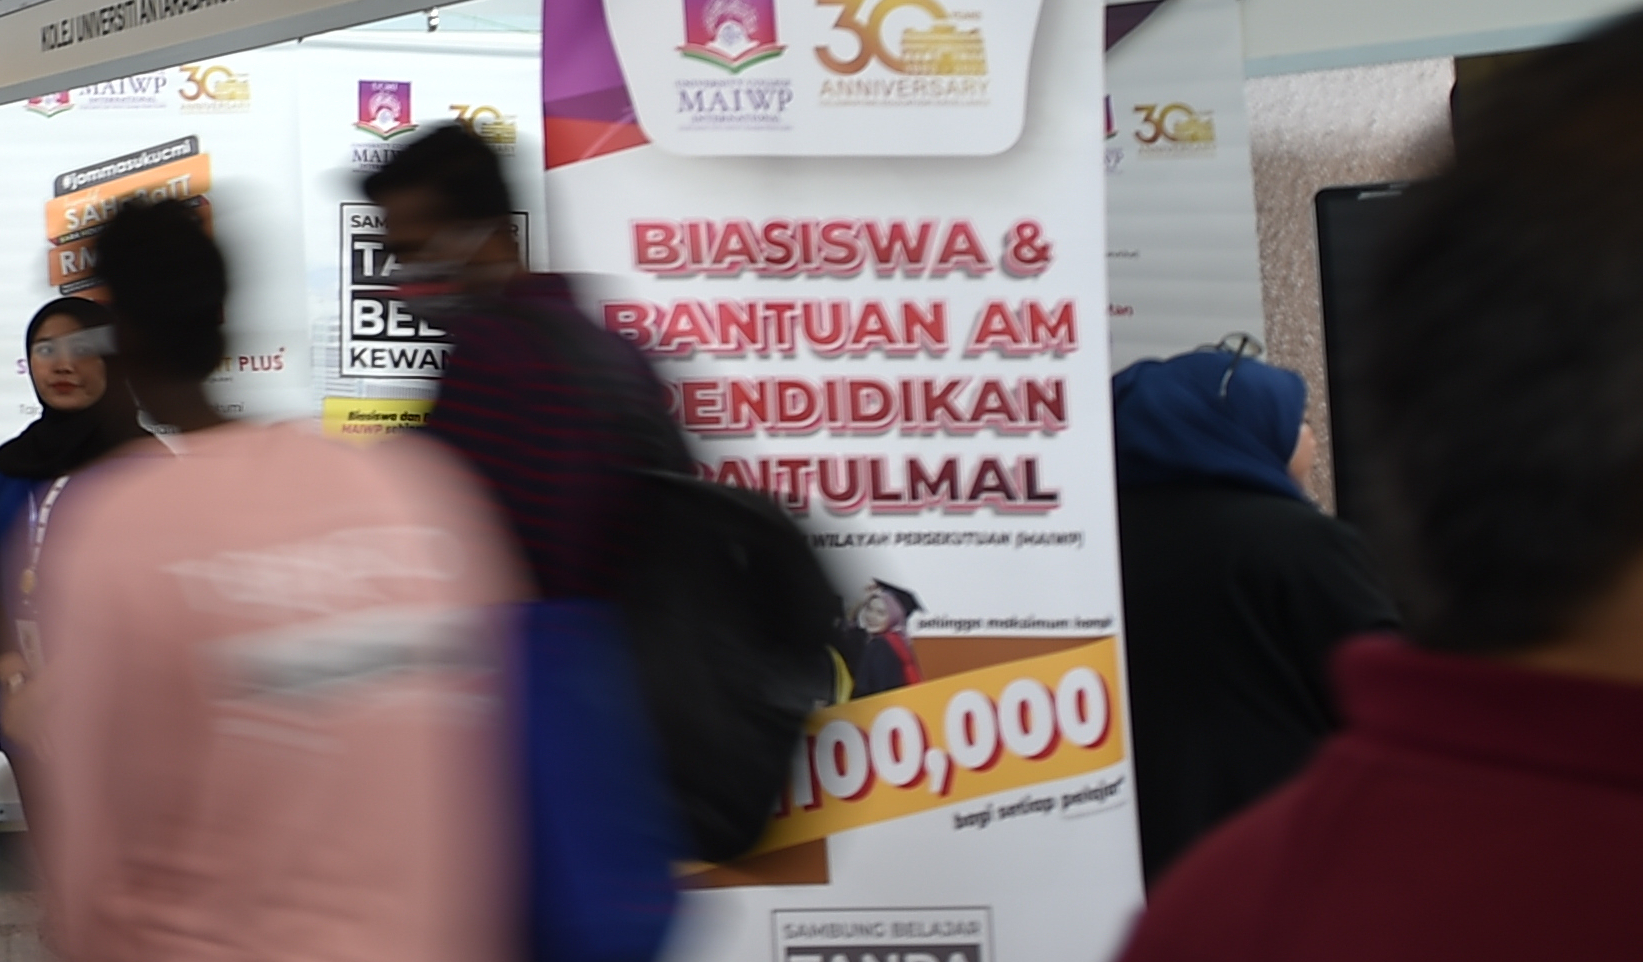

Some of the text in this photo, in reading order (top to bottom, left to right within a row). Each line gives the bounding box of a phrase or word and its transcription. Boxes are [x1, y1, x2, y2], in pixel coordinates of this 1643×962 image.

[41, 17, 74, 52] KOLEJ
[76, 0, 139, 43] UNIVERSITI
[678, 90, 794, 113] MAIWP
[819, 79, 990, 97] ANNIVERSARY
[630, 218, 1054, 277] BIASISWA &
[602, 298, 1079, 358] BANTUAN AM
[238, 356, 283, 371] PLUS
[691, 455, 1062, 517] AITULMAL
